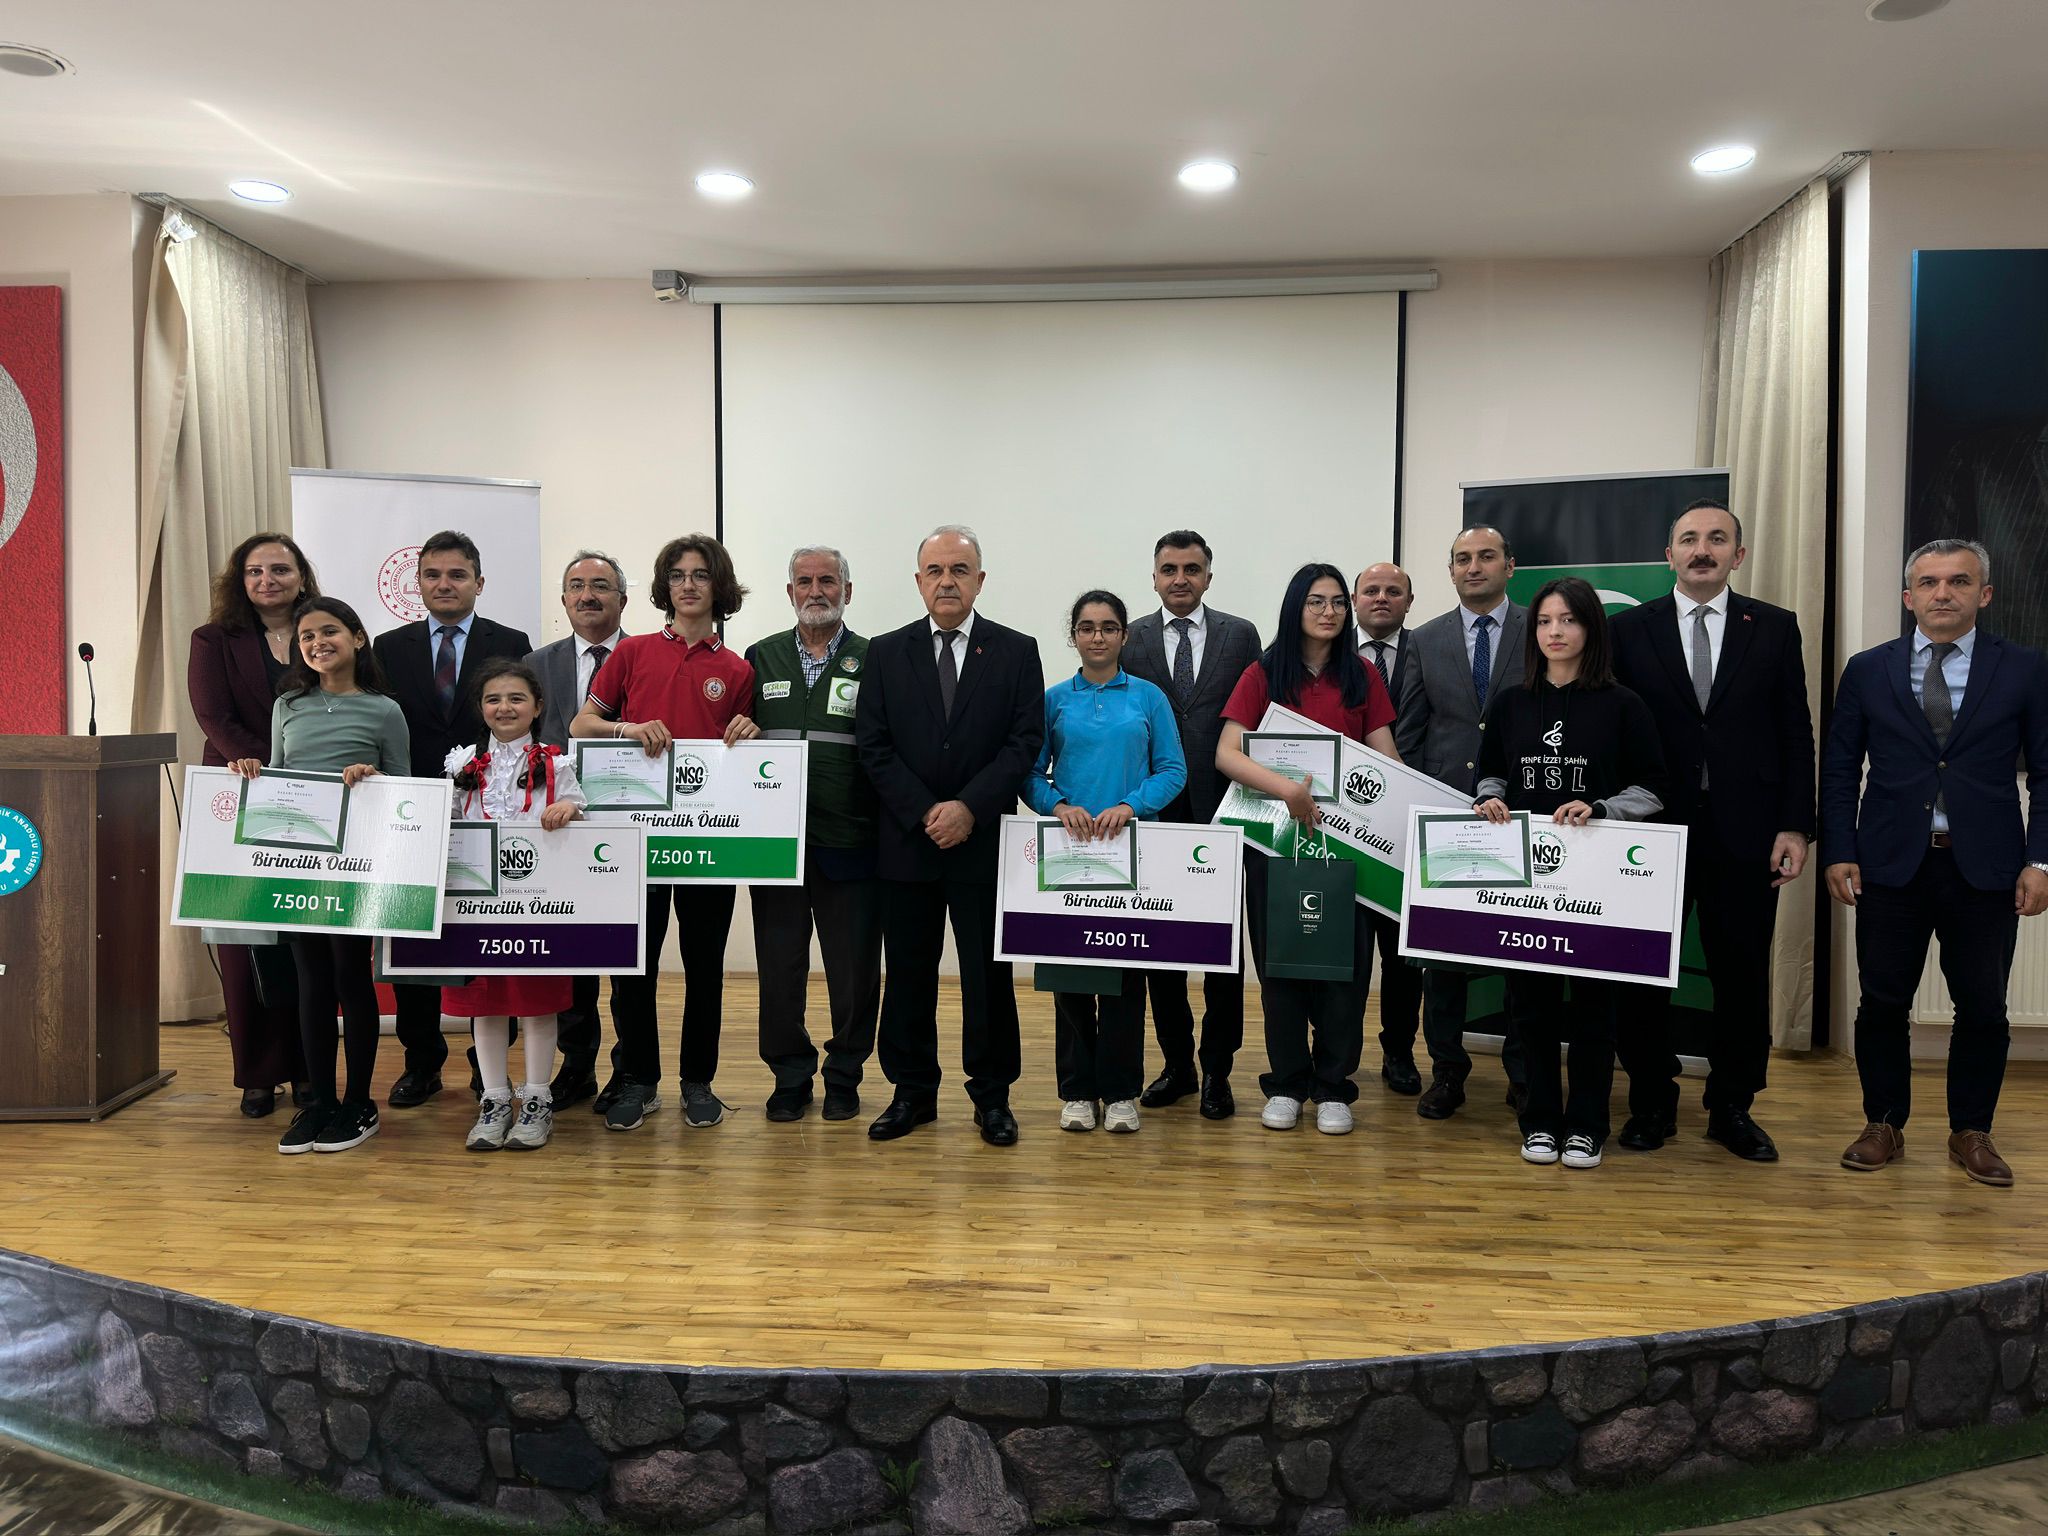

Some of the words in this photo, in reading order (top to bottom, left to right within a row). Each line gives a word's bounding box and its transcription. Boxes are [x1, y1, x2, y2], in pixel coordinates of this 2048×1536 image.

[1564, 755, 1588, 766] ŞAHİN
[753, 781, 782, 790] YEŞİLAY
[1347, 772, 1382, 799] SNSG
[697, 810, 741, 828] Ödülü
[12, 815, 39, 848] ANADOLU
[1354, 825, 1395, 855] Ödülü
[251, 851, 322, 870] Birincilik
[500, 849, 534, 869] SNSG
[650, 850, 693, 864] 7.500
[697, 850, 716, 865] TL
[1533, 843, 1561, 865] NSG
[587, 866, 619, 874] YEŞİLAY
[1187, 866, 1216, 875] YEŞİLAY
[1619, 867, 1654, 877] YEŞİLAY
[272, 893, 320, 910] 7.500
[324, 896, 344, 912] TL
[455, 899, 525, 915] Birincilik
[528, 896, 576, 915] Ödülü
[1063, 892, 1127, 910] Birincilik
[1130, 893, 1175, 912] Ödülü
[1476, 889, 1549, 910] Birincilik
[1553, 893, 1603, 916] Ödülü
[478, 939, 525, 954] 7.500
[529, 939, 551, 954] TL
[1083, 930, 1127, 947] 7.500
[1130, 933, 1149, 948] TL
[1498, 930, 1547, 949] 7.500
[1551, 936, 1574, 954] TL
